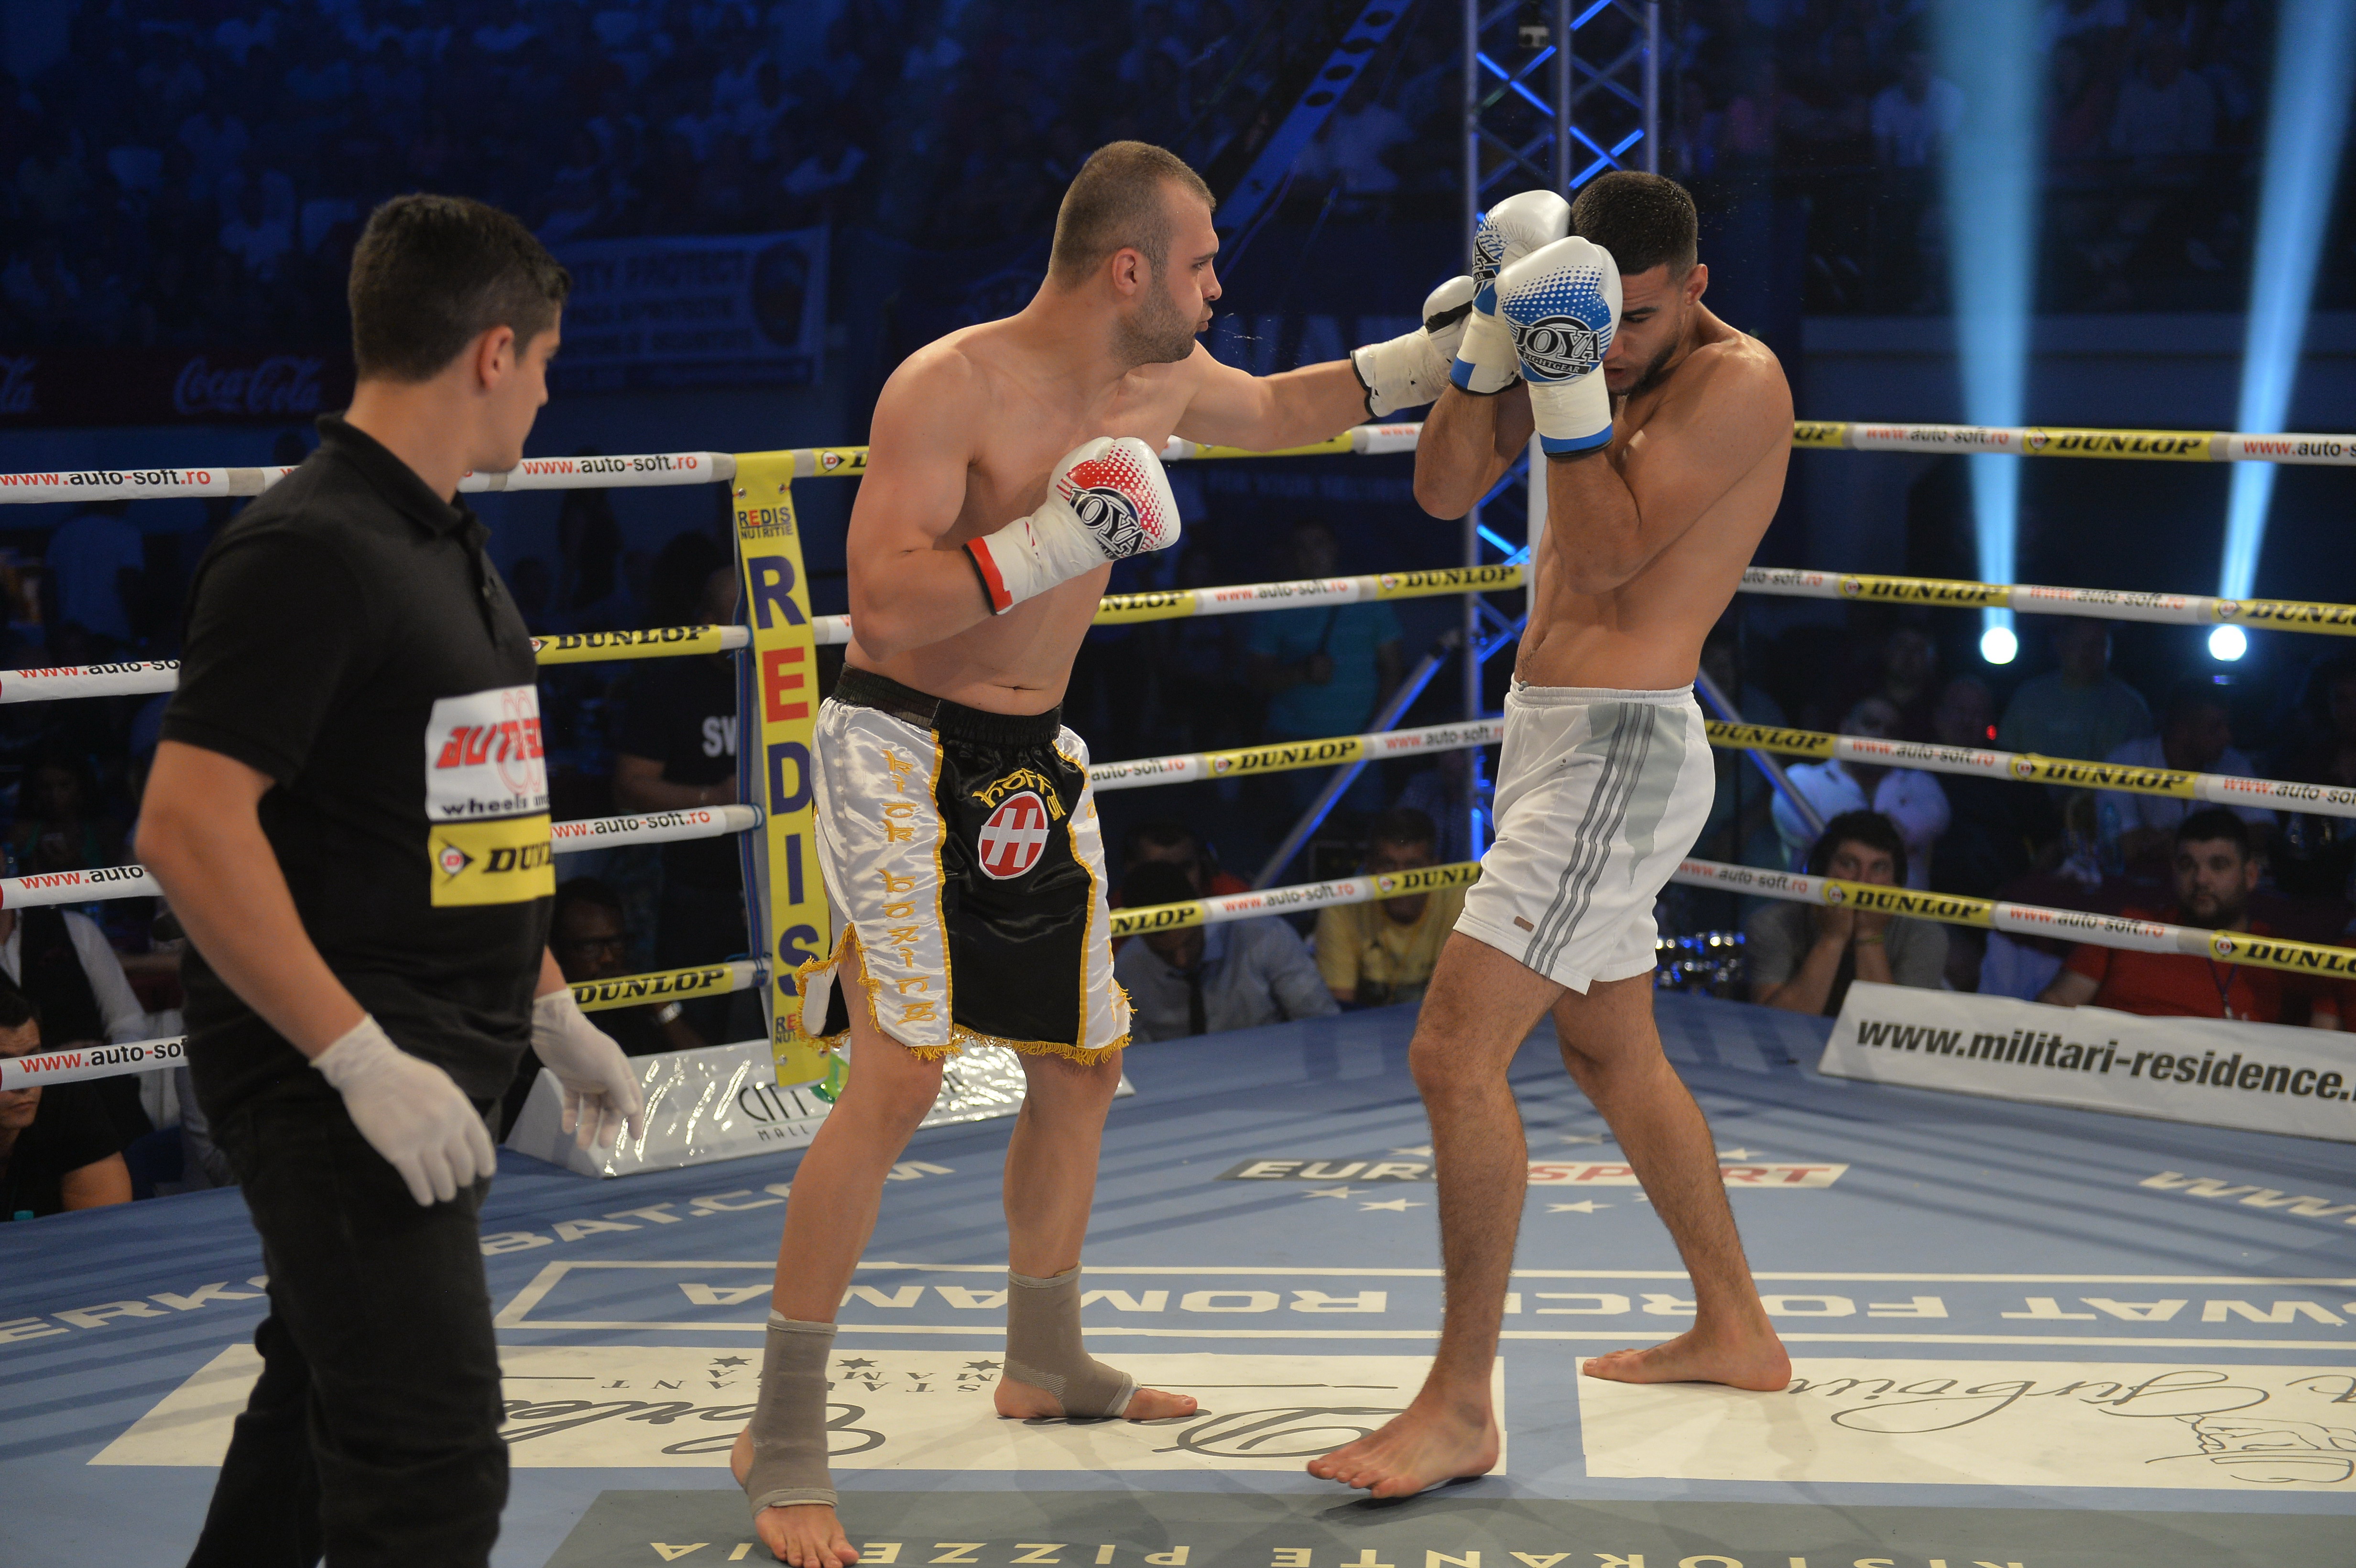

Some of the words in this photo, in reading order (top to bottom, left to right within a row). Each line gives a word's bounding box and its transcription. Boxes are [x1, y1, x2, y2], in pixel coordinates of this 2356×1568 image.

[1514, 323, 1603, 364] JOYA
[1523, 353, 1581, 375] FIGHTGEAR
[1866, 427, 2009, 445] www.auto-soft.ro
[2056, 434, 2202, 454] DUNLOP
[2243, 439, 2356, 458] www.auto-s
[0, 469, 211, 486] www.auto-soft.ro
[522, 455, 698, 475] www.auto-soft.ro
[738, 507, 792, 528] REDIS
[1068, 487, 1146, 557] JOYA
[1102, 591, 1185, 612] NLOP
[1214, 580, 1348, 603] www.auto-soft.ro
[1406, 566, 1515, 588] DUNLOP
[1870, 581, 2003, 602] DUNLOP
[2029, 585, 2187, 610] www.auto-soft.ro
[17, 660, 180, 678] www.auto-so
[556, 623, 710, 650] DUNLOP
[1091, 758, 1186, 782] auto-soft.ro
[1238, 740, 1357, 771] DUNLOP
[1385, 724, 1505, 750] www.auto-soft.r
[1706, 720, 1829, 751] DUNLOP
[1853, 739, 1996, 768] www.auto-soft.ro
[2044, 763, 2187, 790] DUNLOP
[747, 555, 820, 997] REDIS
[442, 794, 527, 815] wheels
[483, 841, 551, 873] DUN
[19, 865, 148, 889] www.auto
[1111, 906, 1196, 934] NLOP
[1223, 882, 1355, 913] www.auto-soft.ro
[1403, 867, 1483, 890] DUNL
[1679, 861, 1808, 894] www.auto-soft.ro
[1854, 891, 1982, 919] DUNLOP
[2009, 905, 2165, 938] www.auto-soft.ro
[571, 968, 725, 1004] DUNLOP
[1857, 1019, 2356, 1102] www.militari-residence.
[757, 1123, 810, 1141] MALL
[1238, 1161, 1437, 1180] EUR
[1528, 1165, 1823, 1185] SPRT
[480, 1160, 955, 1256] BAT.CM
[678, 1282, 1387, 1315] ROMANA
[1440, 1292, 1950, 1319] FORC
[2001, 1296, 2356, 1327] WAT
[600, 1379, 982, 1394] STAANT
[707, 1369, 994, 1382] MAMA
[649, 1543, 1190, 1566] PIZZEIA
